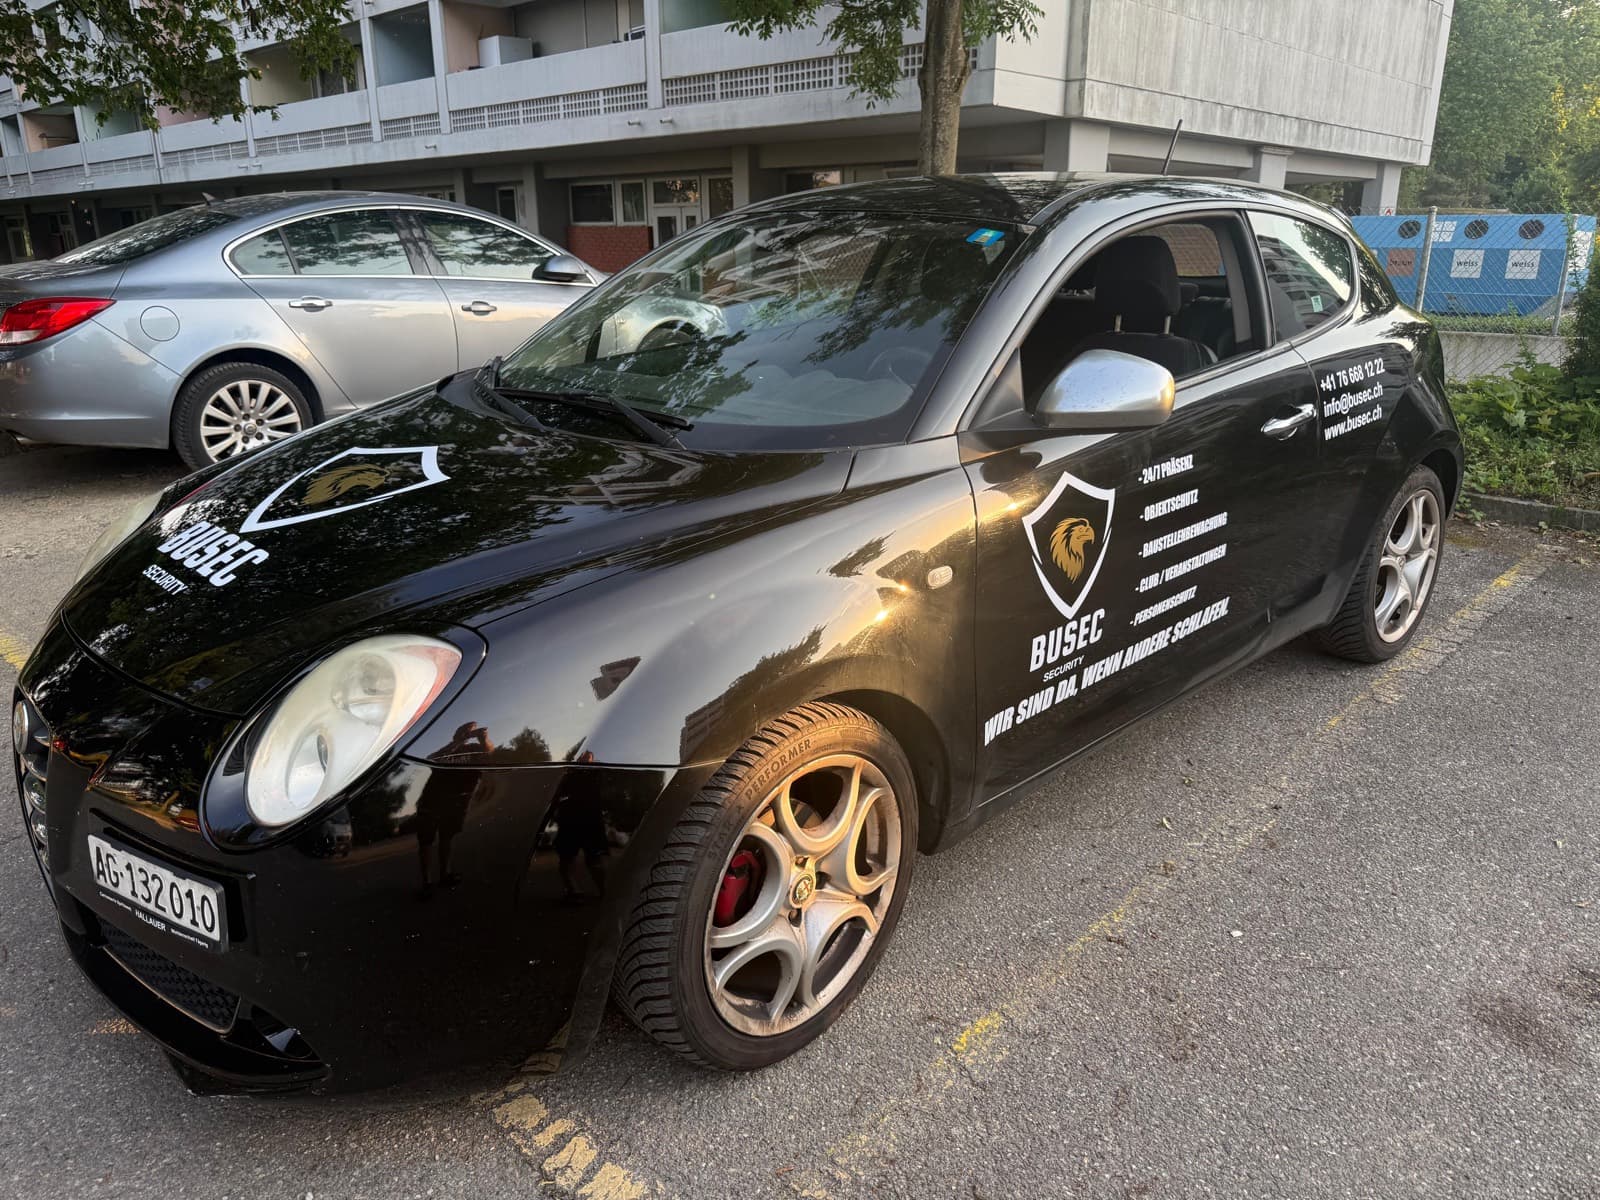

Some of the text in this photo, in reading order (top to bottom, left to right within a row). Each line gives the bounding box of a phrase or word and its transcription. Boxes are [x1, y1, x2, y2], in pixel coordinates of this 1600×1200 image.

[1456, 259, 1479, 268] weiss
[1511, 260, 1535, 268] weiss
[1320, 357, 1386, 391] +41 76 668 12 22
[1323, 381, 1384, 418] info@busec.ch
[1324, 403, 1382, 441] www.busec.ch
[1161, 454, 1194, 478] PRÄSENZ
[157, 521, 270, 587] BUSEC
[1164, 543, 1227, 582] VERANSTALTUNGEN
[142, 564, 189, 596] SECURITY
[1030, 608, 1105, 673] BUSEC
[1043, 655, 1085, 682] SECURITY
[984, 706, 1015, 747] WIR
[1016, 686, 1055, 725] SIND
[1054, 674, 1079, 705] DA,
[1081, 649, 1124, 690] WENN
[1121, 626, 1173, 670] ANDERE
[744, 738, 812, 800] PERFORMER
[135, 908, 167, 932] HALLAUER
